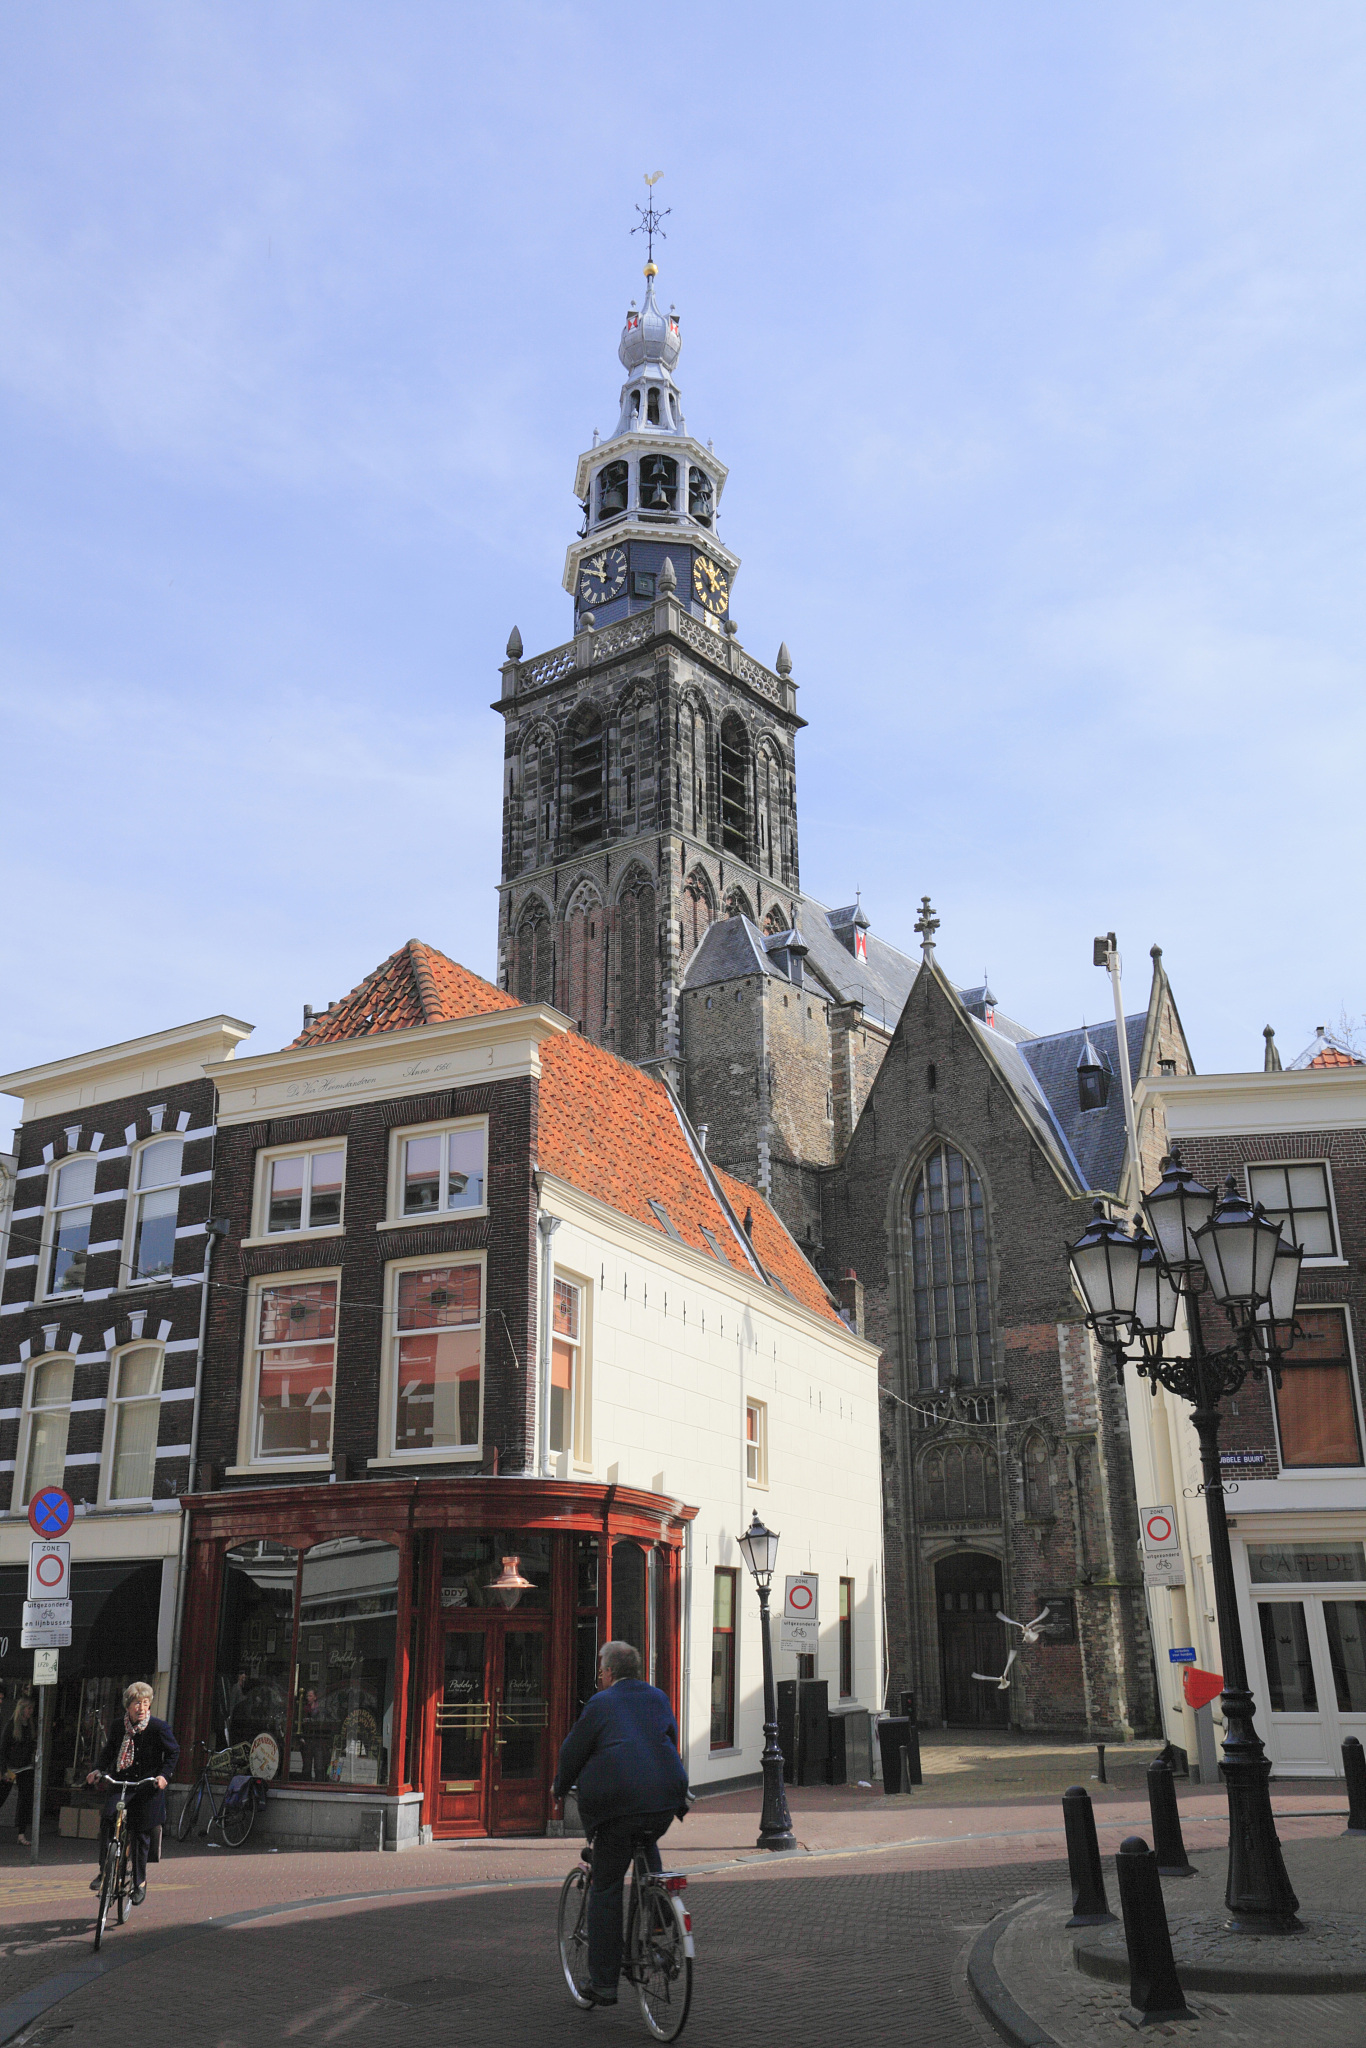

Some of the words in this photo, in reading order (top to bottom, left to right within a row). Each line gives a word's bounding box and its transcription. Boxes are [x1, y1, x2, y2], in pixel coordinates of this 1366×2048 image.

[286, 1083, 300, 1098] De
[402, 1062, 430, 1077] Anno
[1219, 1455, 1241, 1464] UBBELE
[1243, 1455, 1264, 1463] BUURT
[1146, 1552, 1180, 1560] uitgezonderd
[1260, 1553, 1318, 1573] CAFE
[1324, 1554, 1356, 1571] DE
[328, 1649, 365, 1670] Paddy's
[449, 1679, 480, 1694] Paddy's
[509, 1678, 539, 1693] Paddy's
